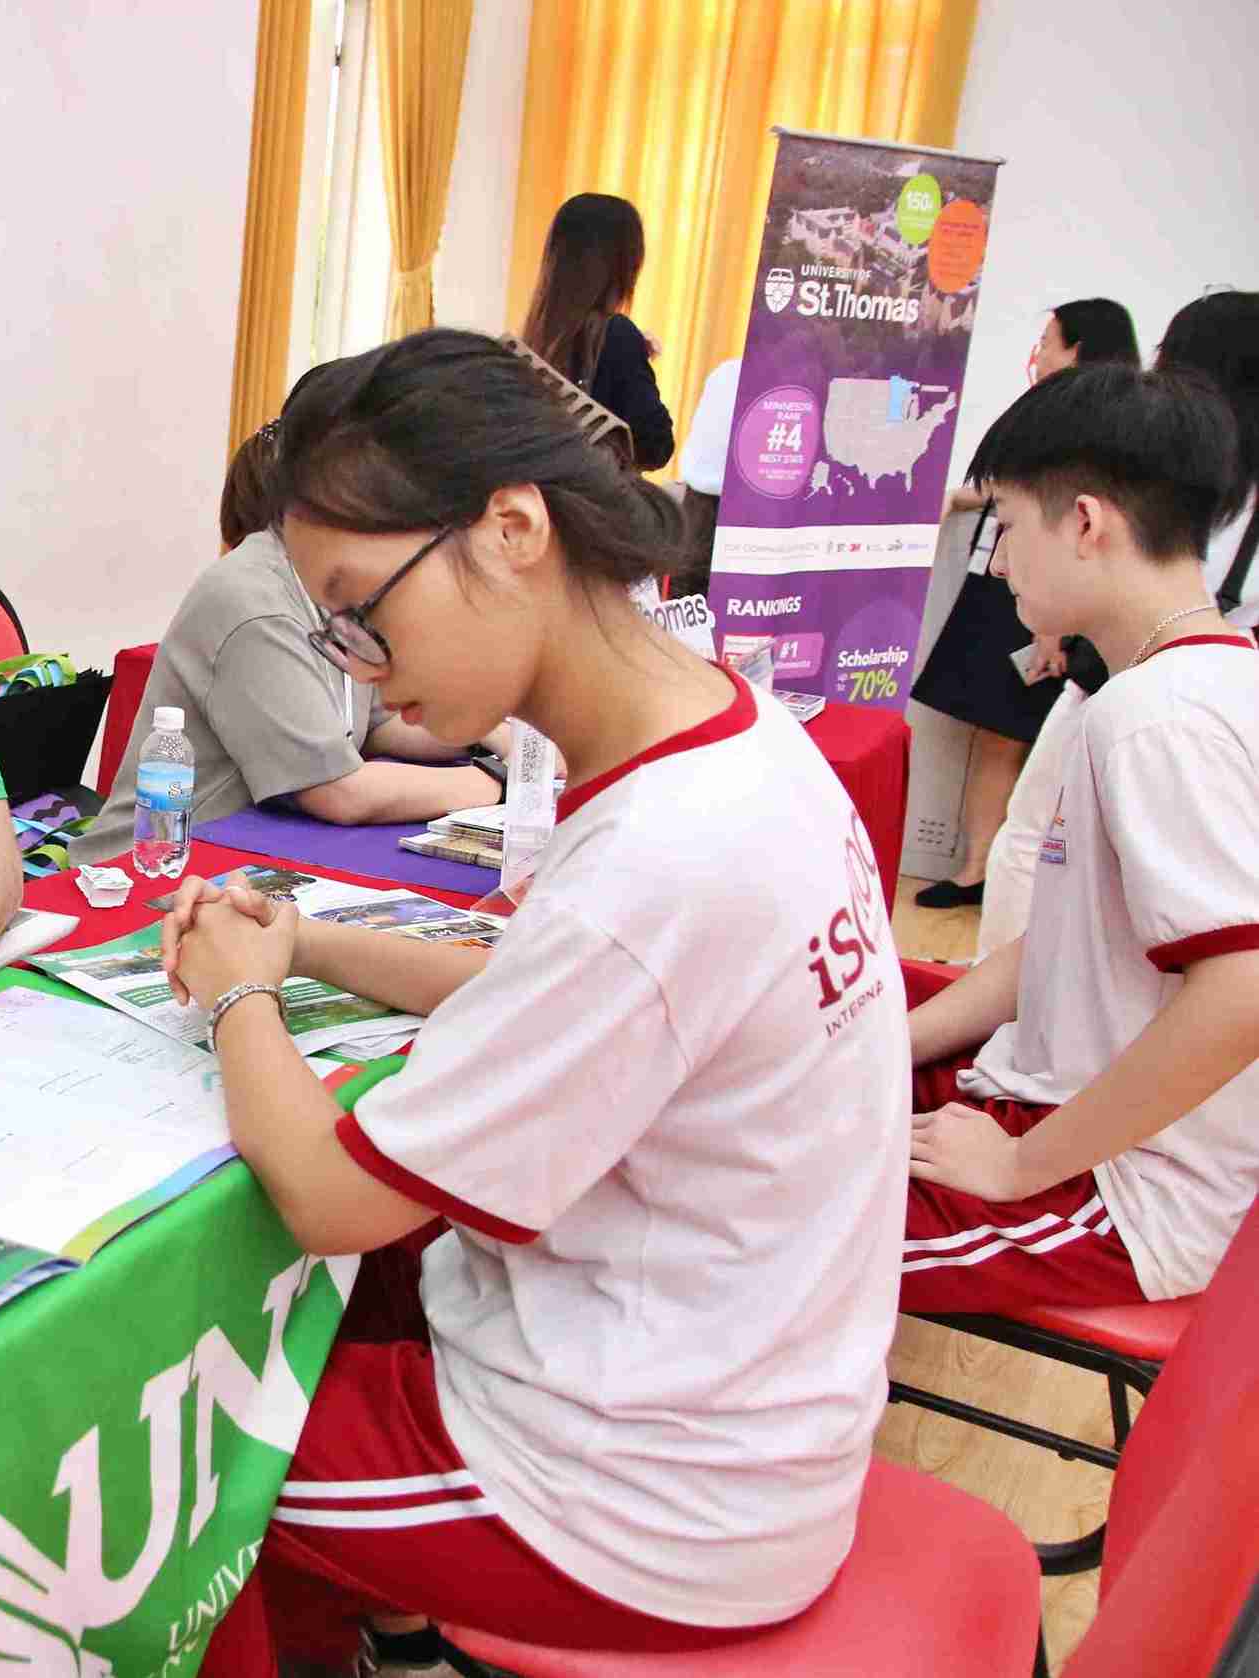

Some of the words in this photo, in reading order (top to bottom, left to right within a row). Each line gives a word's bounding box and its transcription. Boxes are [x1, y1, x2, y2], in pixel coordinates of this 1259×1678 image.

[767, 422, 803, 452] #4
[726, 597, 802, 616] RANKINGS
[779, 640, 799, 659] #1
[837, 646, 909, 668] Scholarship
[849, 668, 898, 702] 70%
